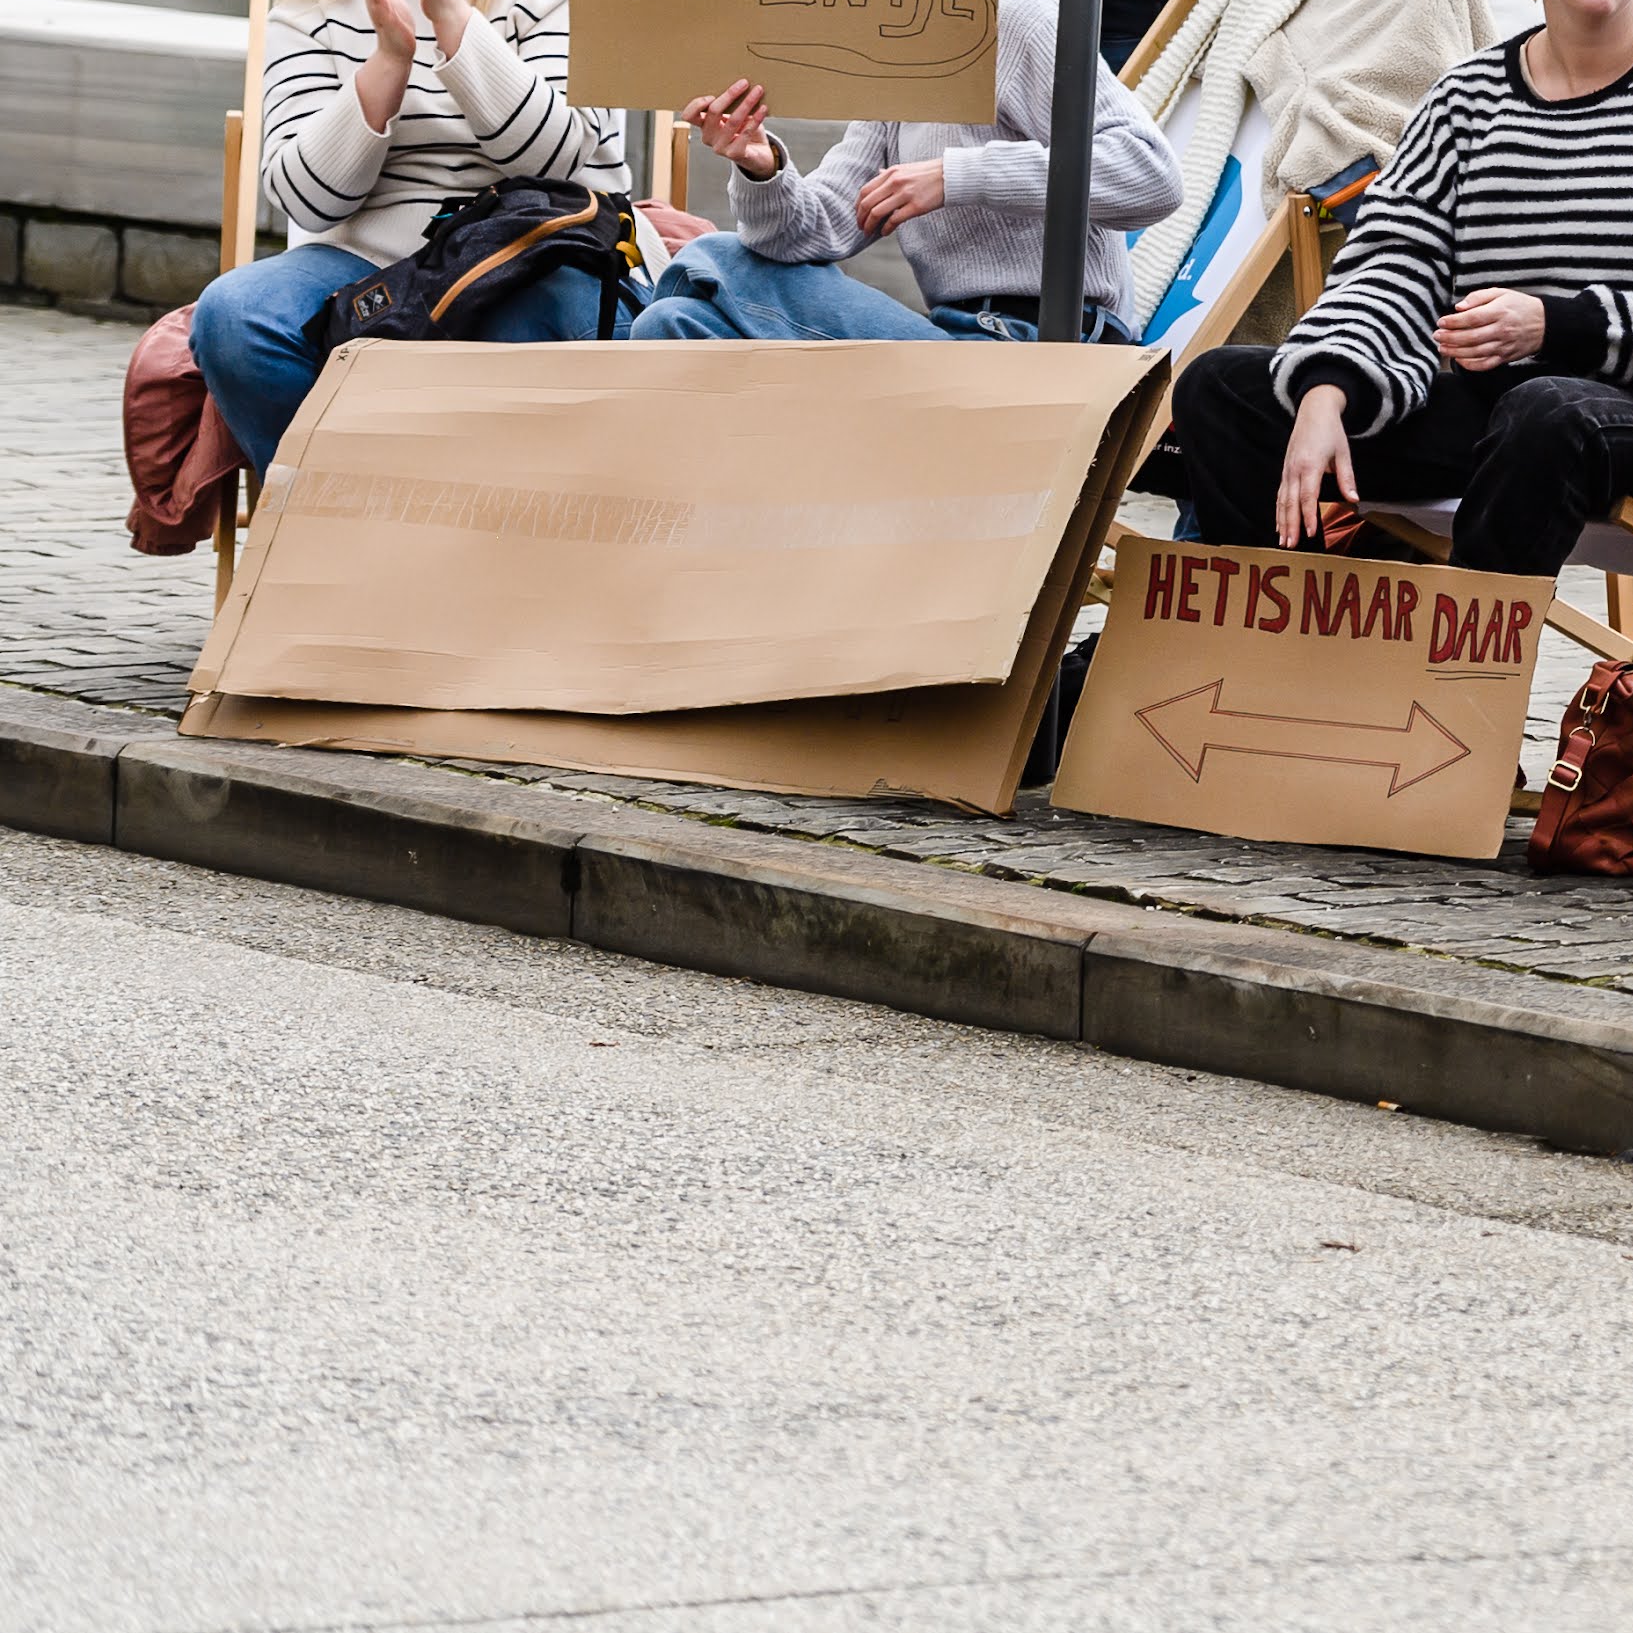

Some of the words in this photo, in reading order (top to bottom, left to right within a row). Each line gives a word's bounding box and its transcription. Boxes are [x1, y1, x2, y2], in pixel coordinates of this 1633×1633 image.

[1143, 553, 1240, 627] HET
[1243, 564, 1291, 634] IS
[1300, 569, 1419, 642] NAAR
[1427, 591, 1533, 664] DAAR
